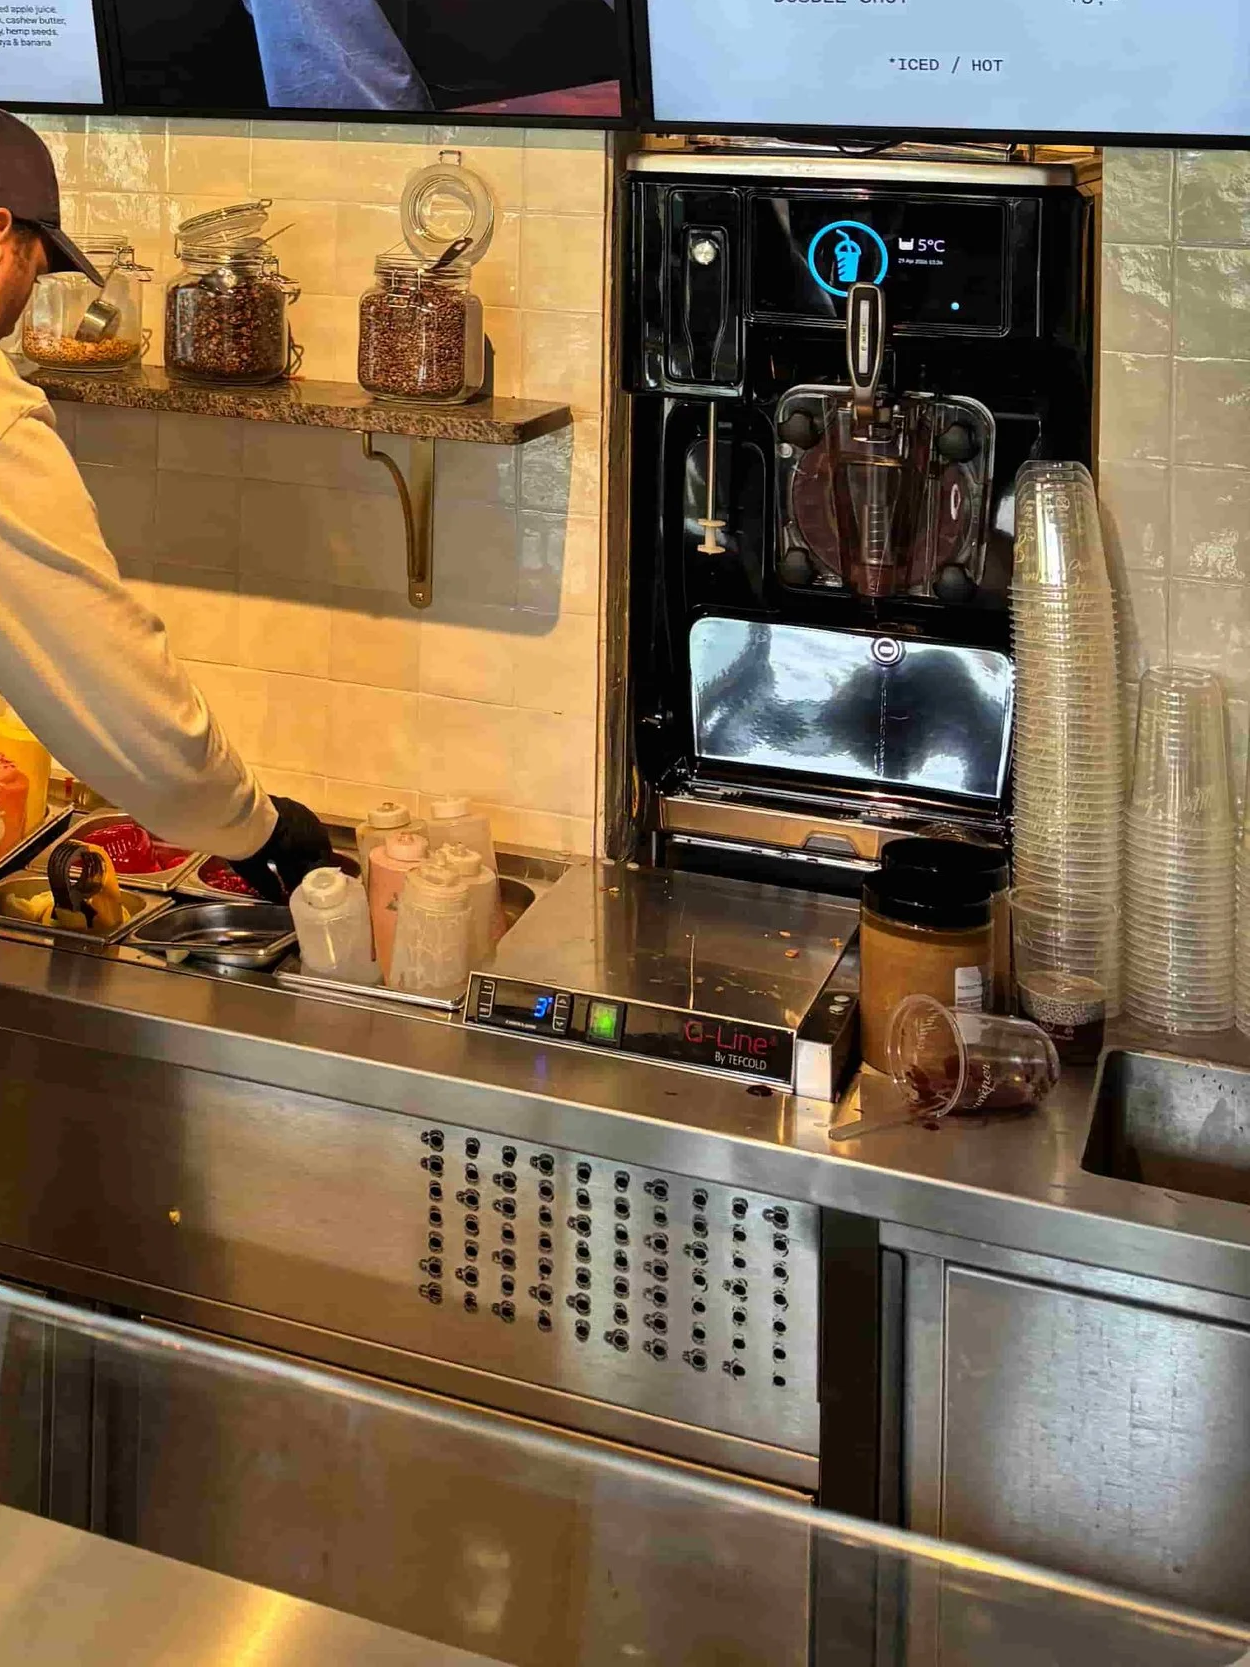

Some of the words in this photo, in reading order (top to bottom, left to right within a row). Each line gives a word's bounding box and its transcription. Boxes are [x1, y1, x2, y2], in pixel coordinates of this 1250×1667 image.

[972, 59, 1003, 71] HOT
[917, 238, 946, 253] 5°C
[714, 1051, 726, 1065] By
[728, 1053, 767, 1071] TEFCOLD
[969, 1063, 997, 1110] uniper
